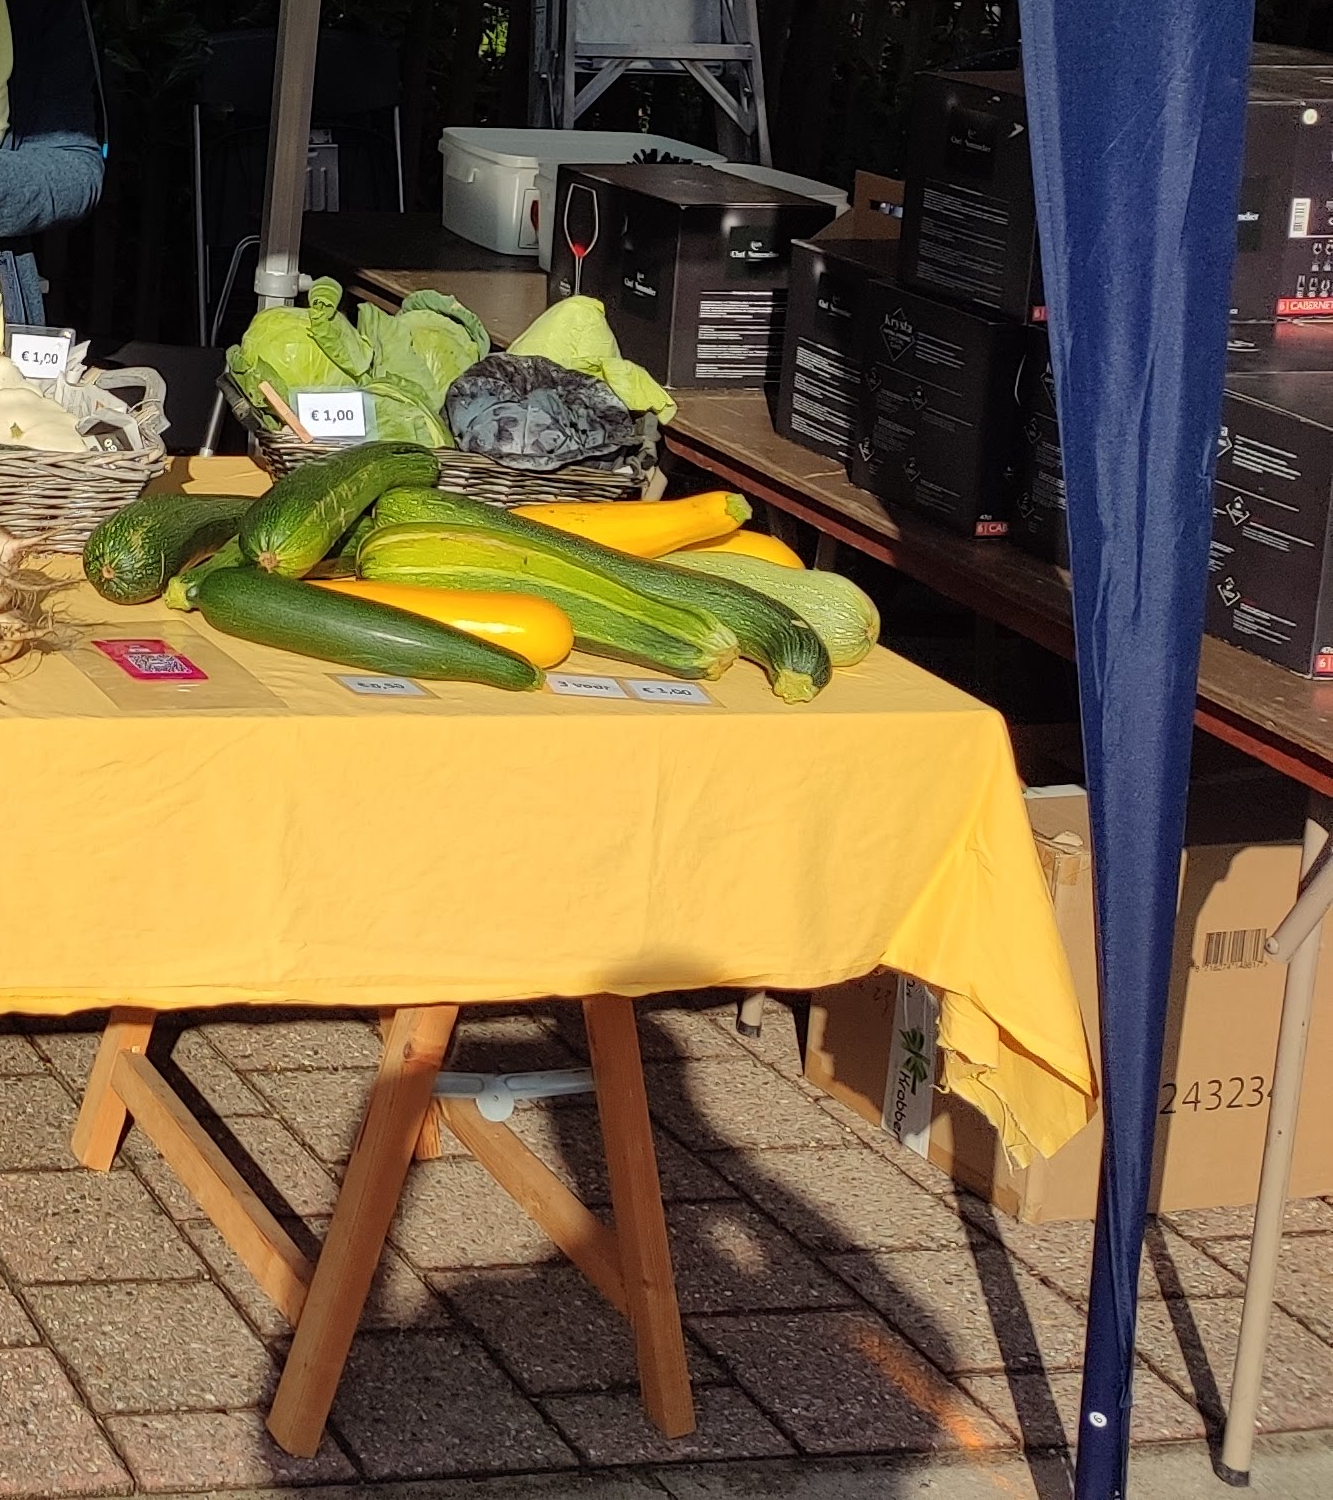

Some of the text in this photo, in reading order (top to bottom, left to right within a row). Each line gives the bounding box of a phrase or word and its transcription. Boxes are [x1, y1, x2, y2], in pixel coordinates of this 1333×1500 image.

[20, 351, 59, 366] € 1,00
[310, 409, 355, 425] € 1,00
